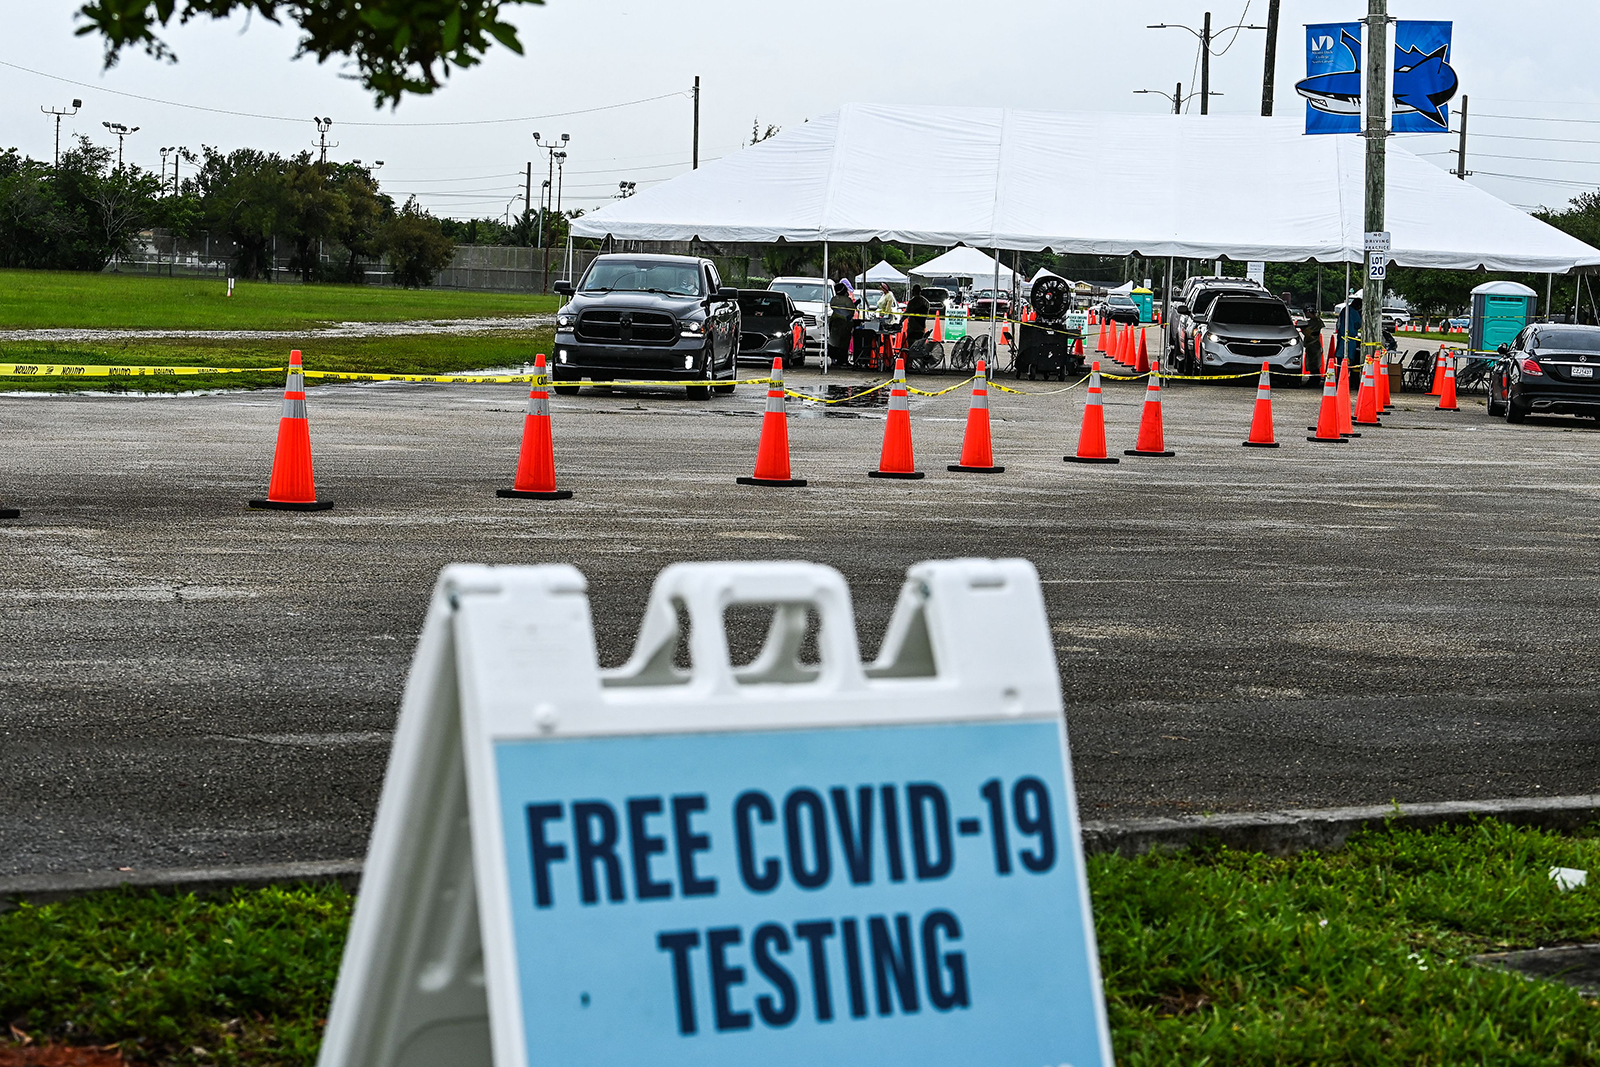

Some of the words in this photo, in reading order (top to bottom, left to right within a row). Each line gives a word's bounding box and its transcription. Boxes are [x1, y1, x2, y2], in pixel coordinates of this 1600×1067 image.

[1372, 256, 1382, 264] LOT
[1370, 266, 1384, 276] 20
[13, 366, 38, 374] CAUTION
[60, 366, 85, 375] CAUTION
[526, 793, 718, 909] FREE
[732, 775, 1058, 893] COVID-19
[656, 908, 972, 1037] TESTING
